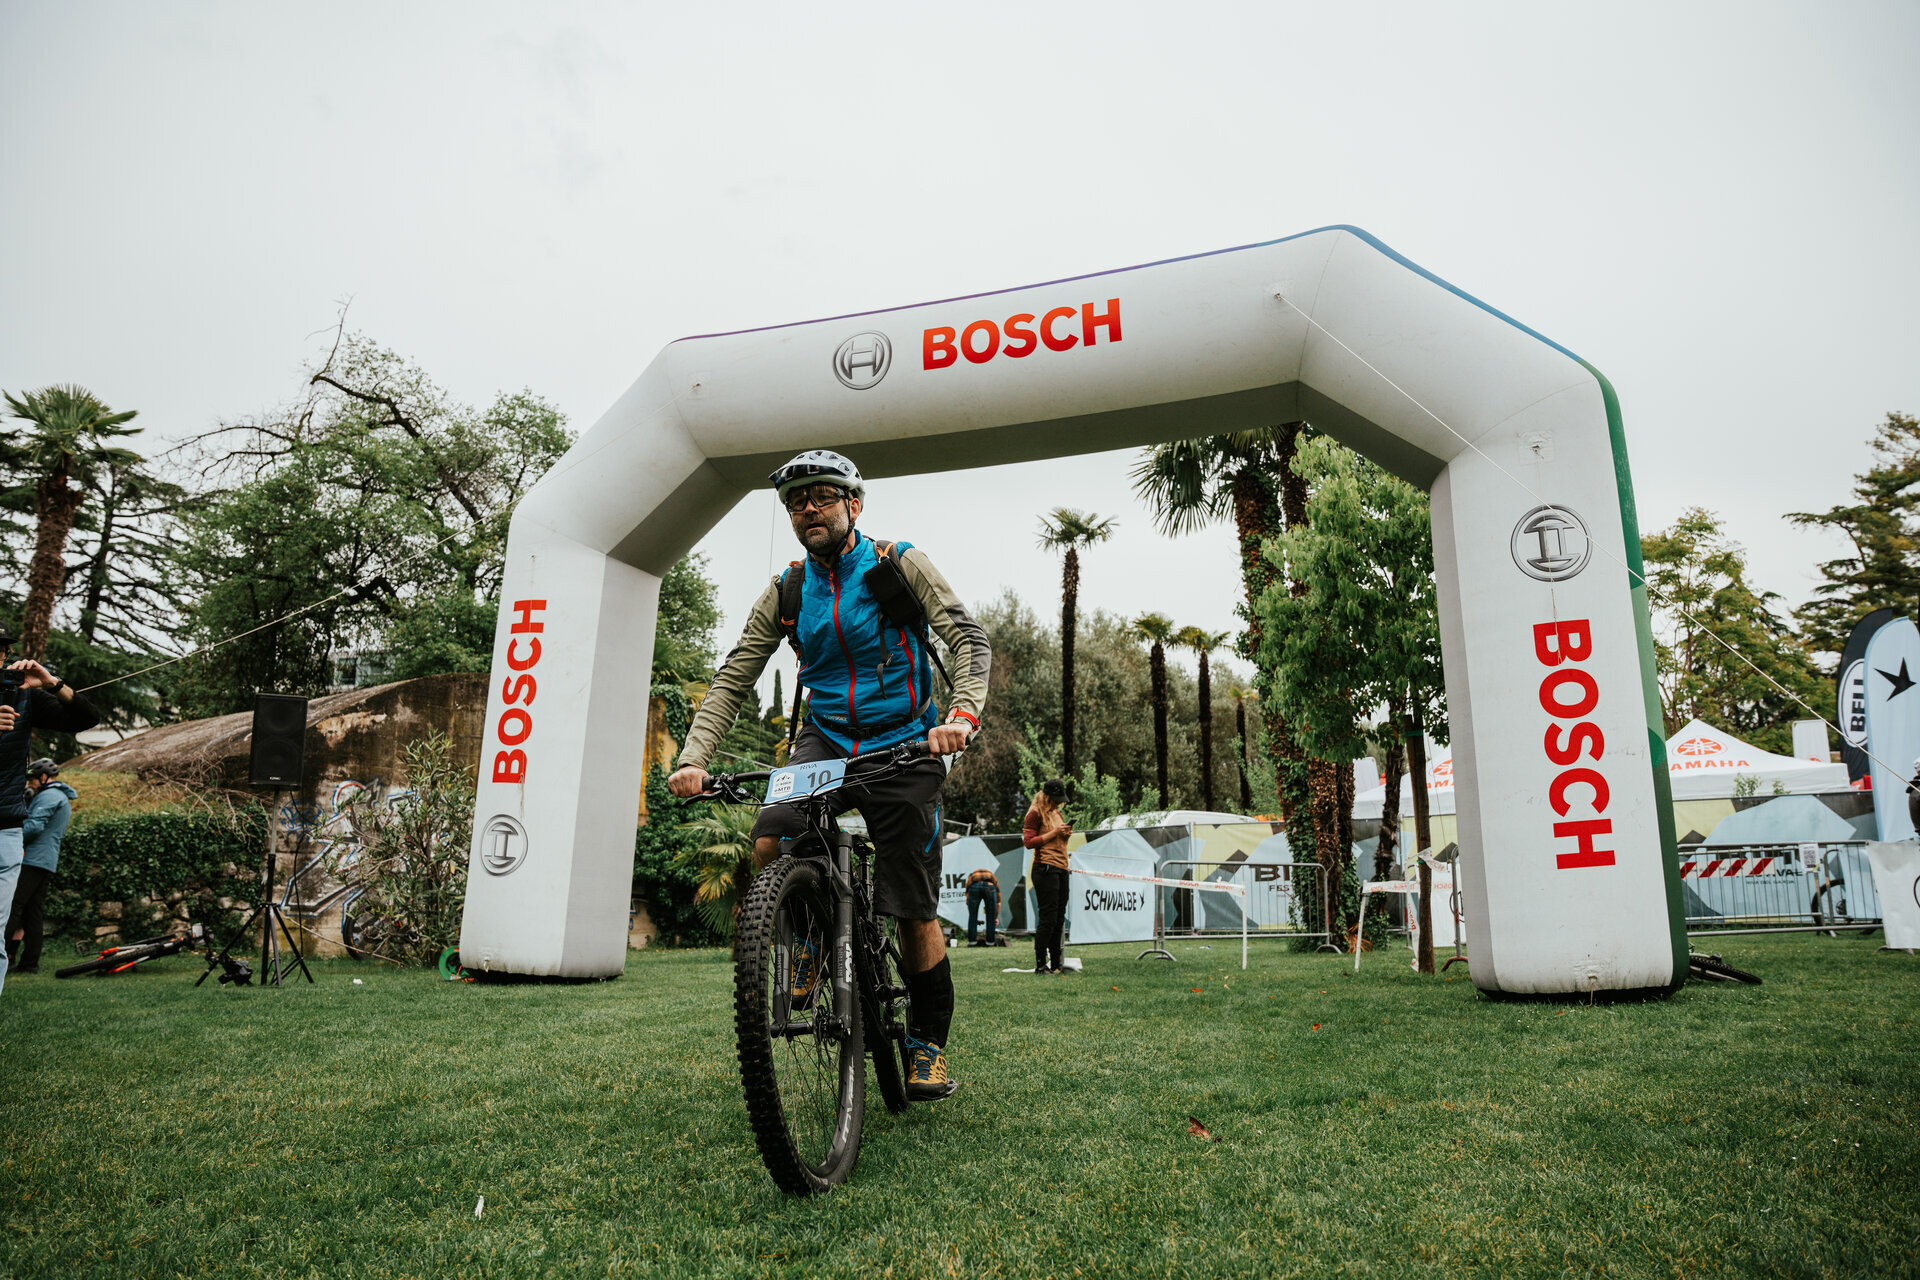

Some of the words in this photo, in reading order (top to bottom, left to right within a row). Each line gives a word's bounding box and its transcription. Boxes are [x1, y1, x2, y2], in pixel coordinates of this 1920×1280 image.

[923, 298, 1122, 370] BOSCH
[492, 600, 547, 784] BOSCH
[1533, 619, 1616, 870] BOSCH
[1671, 760, 1750, 771] AMAHA
[807, 770, 831, 788] 10
[940, 873, 967, 889] IK
[1084, 889, 1137, 911] SCHWALBE
